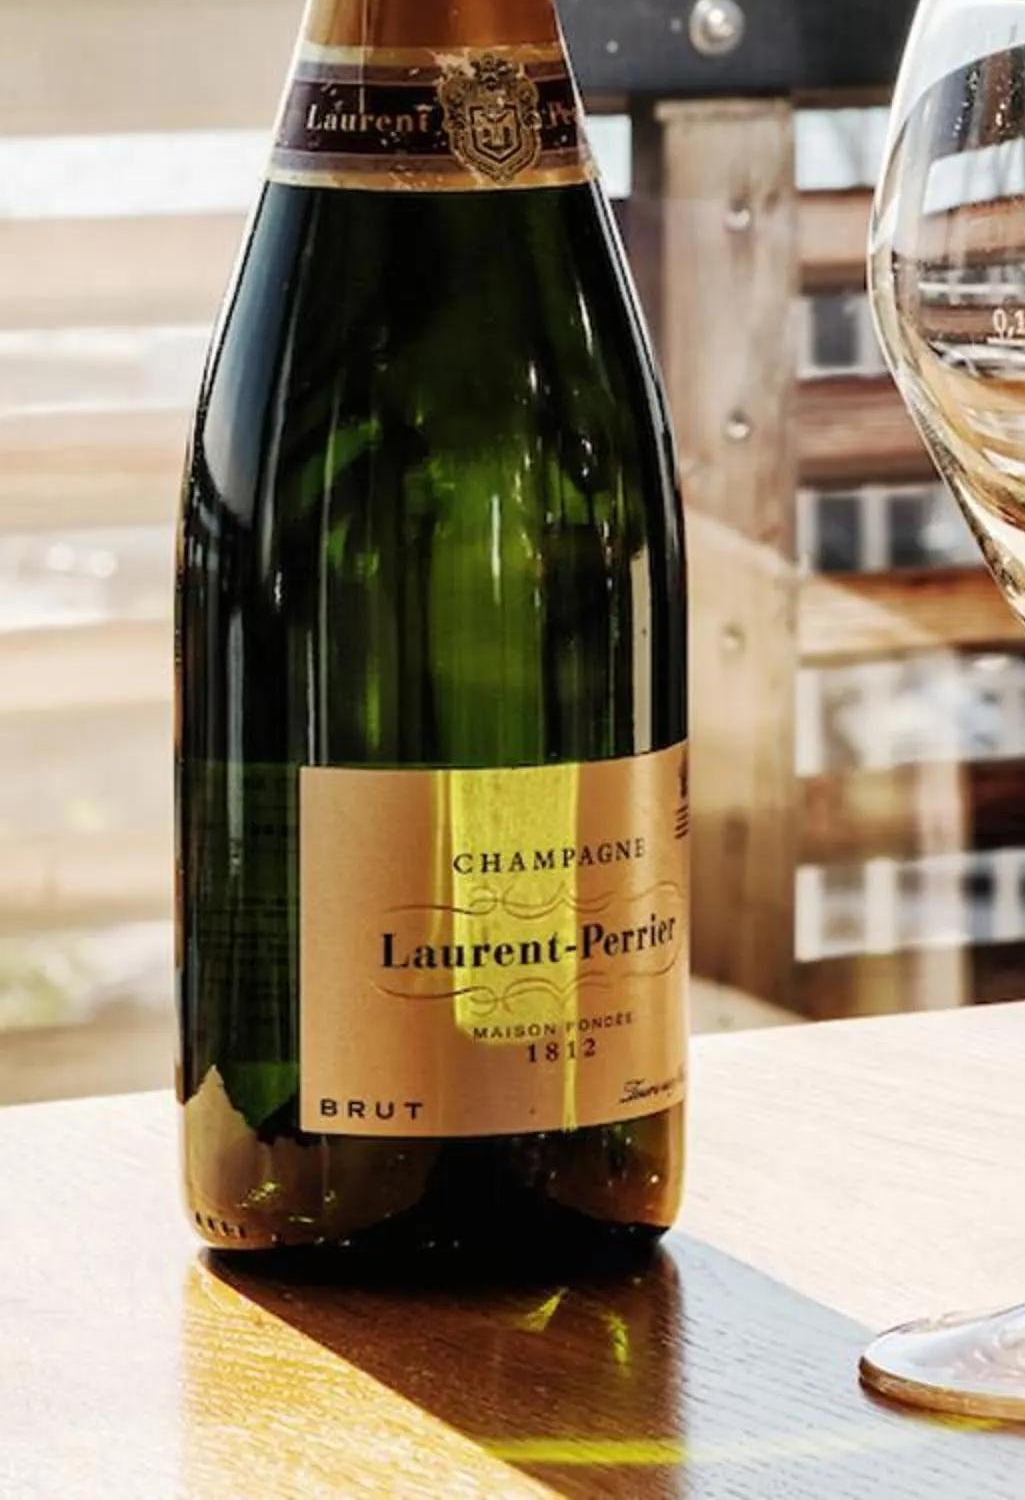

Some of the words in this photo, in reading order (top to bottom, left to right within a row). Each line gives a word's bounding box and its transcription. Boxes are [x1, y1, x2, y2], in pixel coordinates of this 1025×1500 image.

[306, 102, 435, 132] Laurent
[452, 838, 645, 874] CHAMPAGNE
[380, 913, 676, 970] Laurent-Perrier
[473, 1023, 556, 1039] MAISON
[527, 1037, 597, 1063] 1812
[319, 1098, 424, 1121] BRUT
